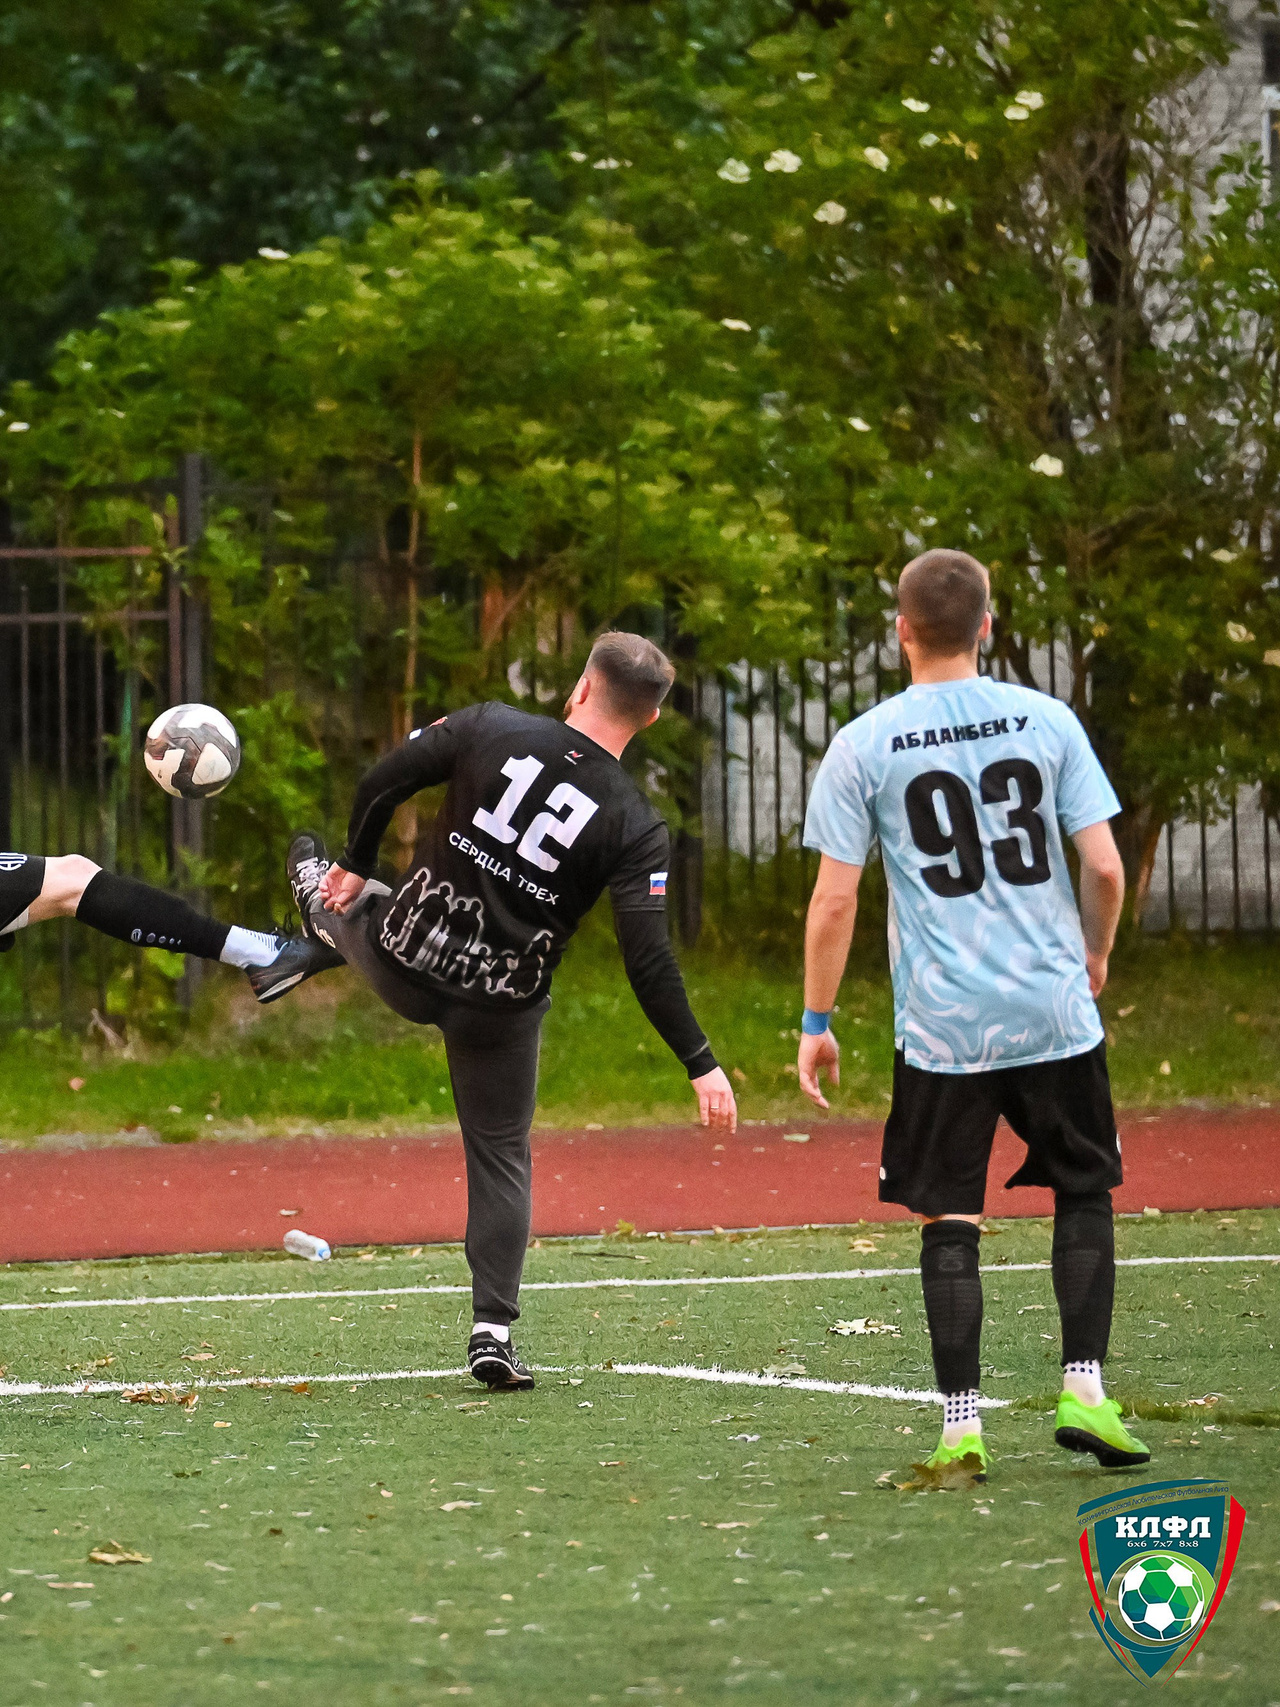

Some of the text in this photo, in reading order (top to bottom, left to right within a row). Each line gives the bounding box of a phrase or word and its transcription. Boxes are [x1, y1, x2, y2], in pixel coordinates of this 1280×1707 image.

[448, 831, 560, 906] СЕРДЦА ТРЕХ
[472, 754, 600, 873] 12
[904, 757, 1052, 898] 93
